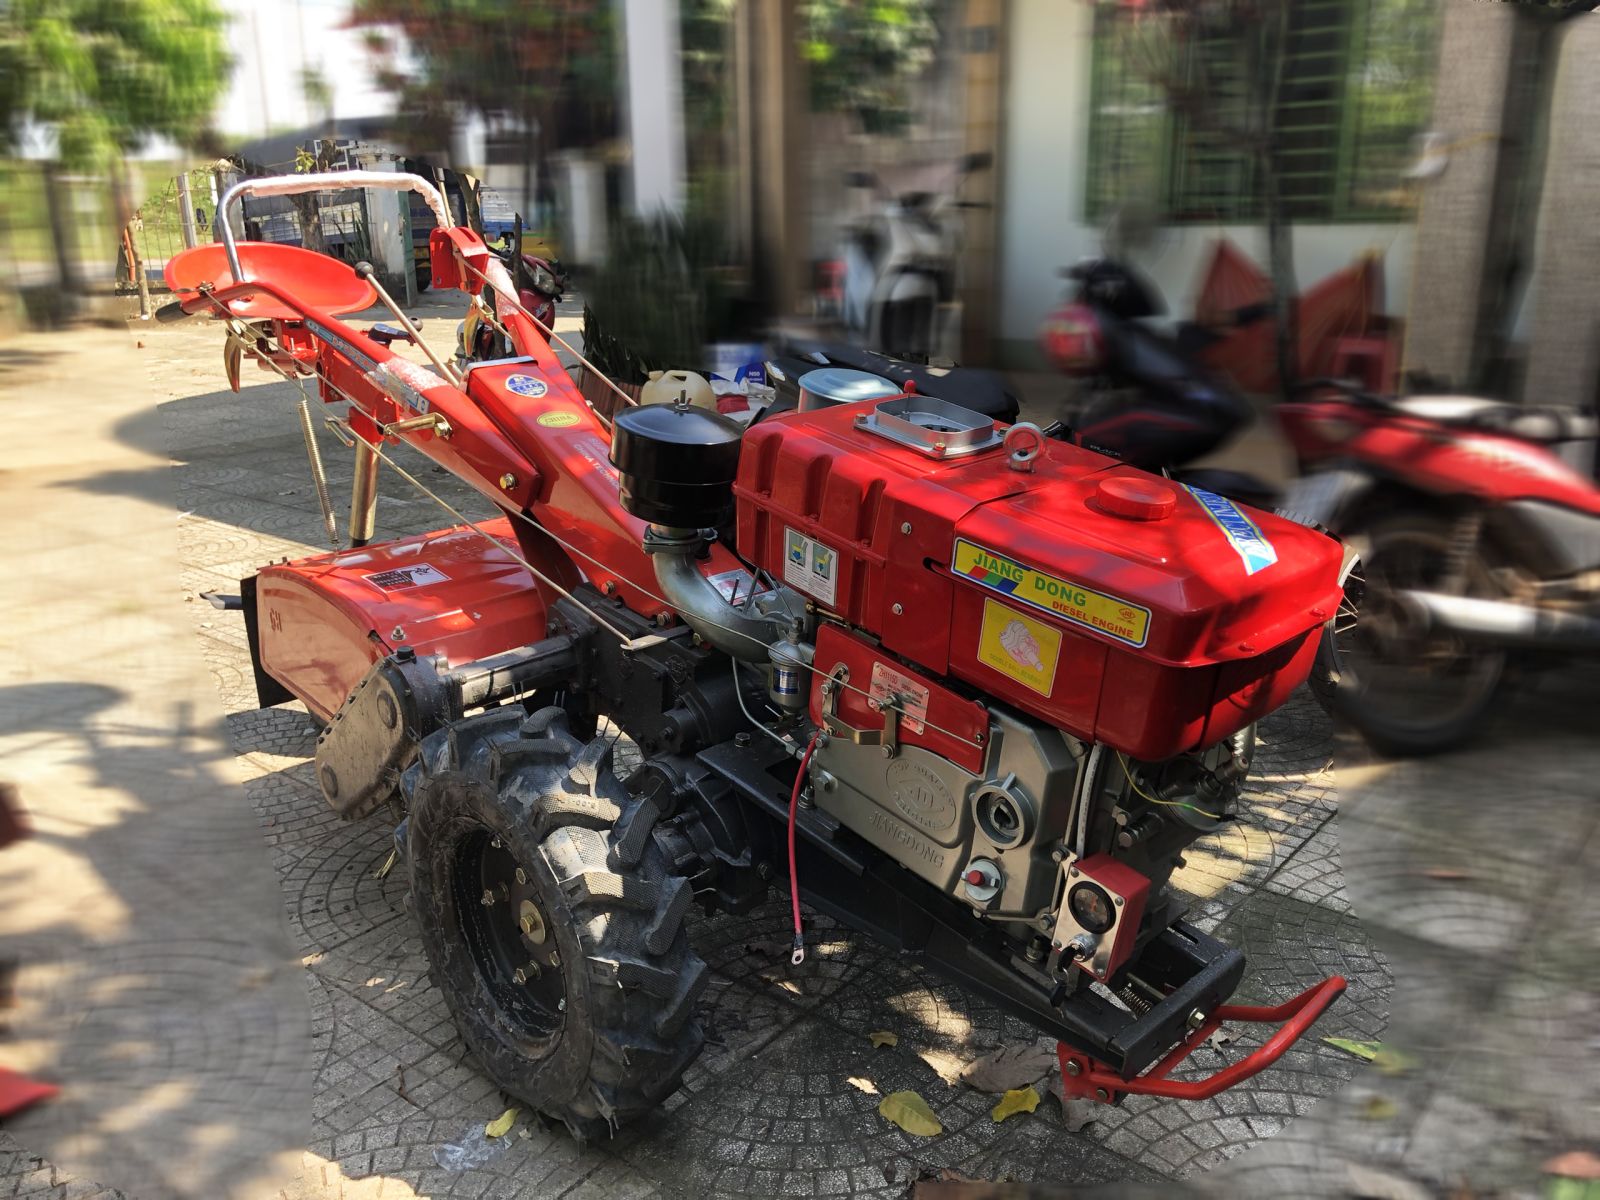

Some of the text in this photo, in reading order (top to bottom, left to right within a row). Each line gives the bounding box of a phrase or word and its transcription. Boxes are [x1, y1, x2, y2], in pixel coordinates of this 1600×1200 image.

[974, 553, 1086, 606] JIANG DONG
[1052, 600, 1090, 623] DIESEL
[1091, 615, 1135, 638] ENGINE
